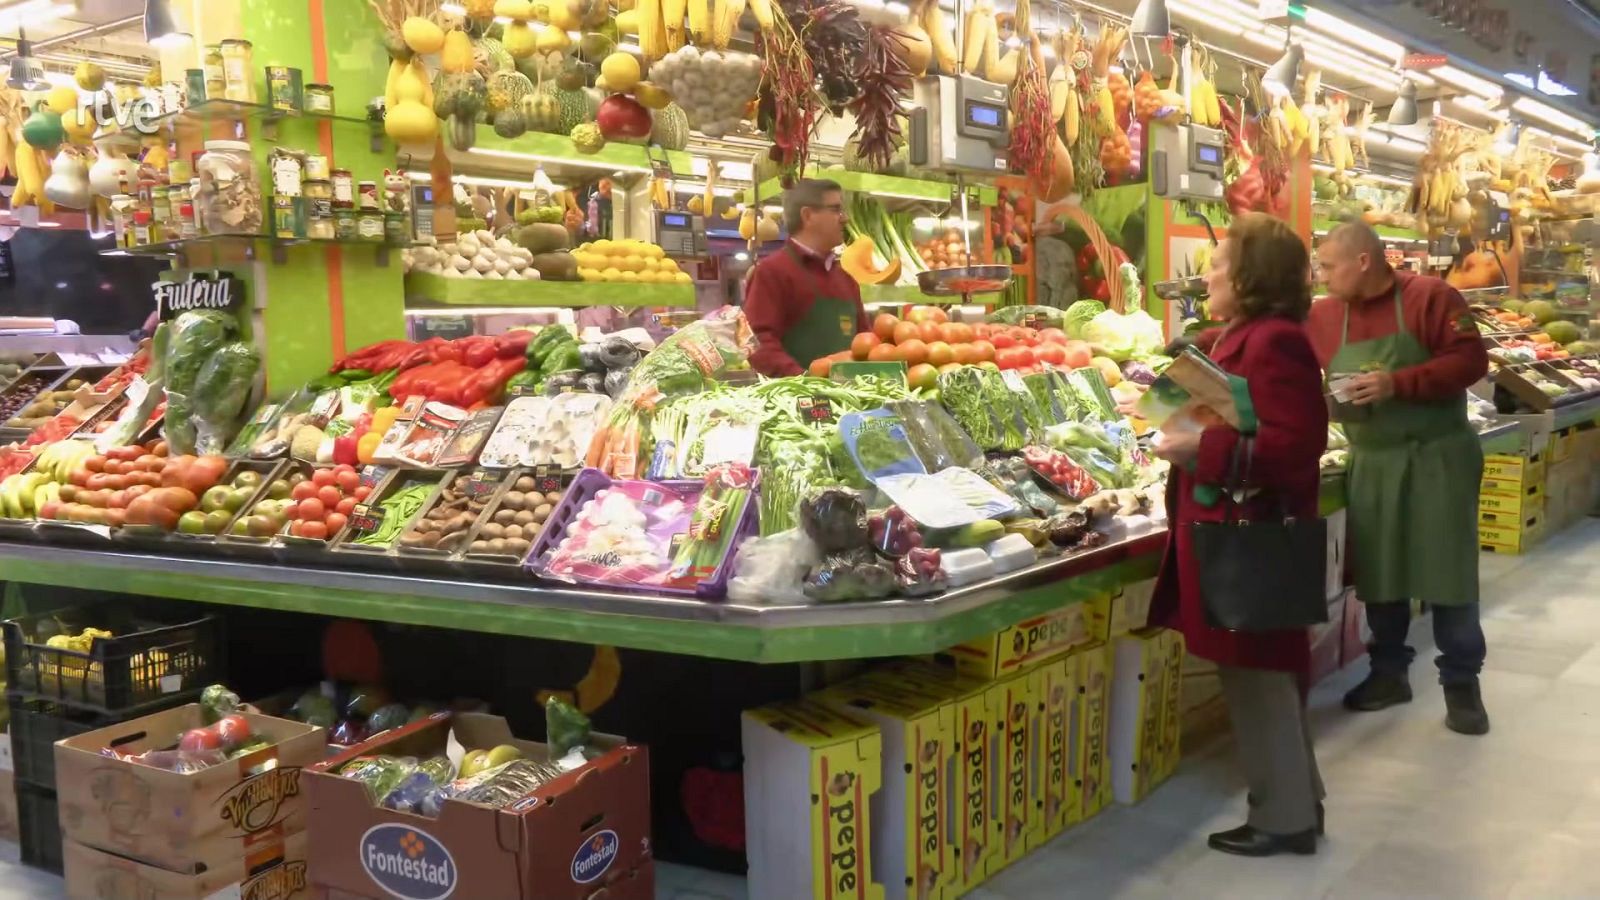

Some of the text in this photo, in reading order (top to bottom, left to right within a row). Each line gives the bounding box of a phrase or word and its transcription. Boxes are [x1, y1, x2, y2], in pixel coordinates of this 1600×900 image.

[1027, 617, 1068, 654] pepe
[1010, 728, 1024, 806] pepe
[1051, 710, 1063, 785] pepe
[1088, 699, 1100, 767] pepe
[920, 767, 938, 854] pepe
[968, 747, 983, 828] pepe
[367, 843, 449, 887] Fontestad
[575, 841, 615, 877] Fontestad
[830, 801, 856, 893] pepe
